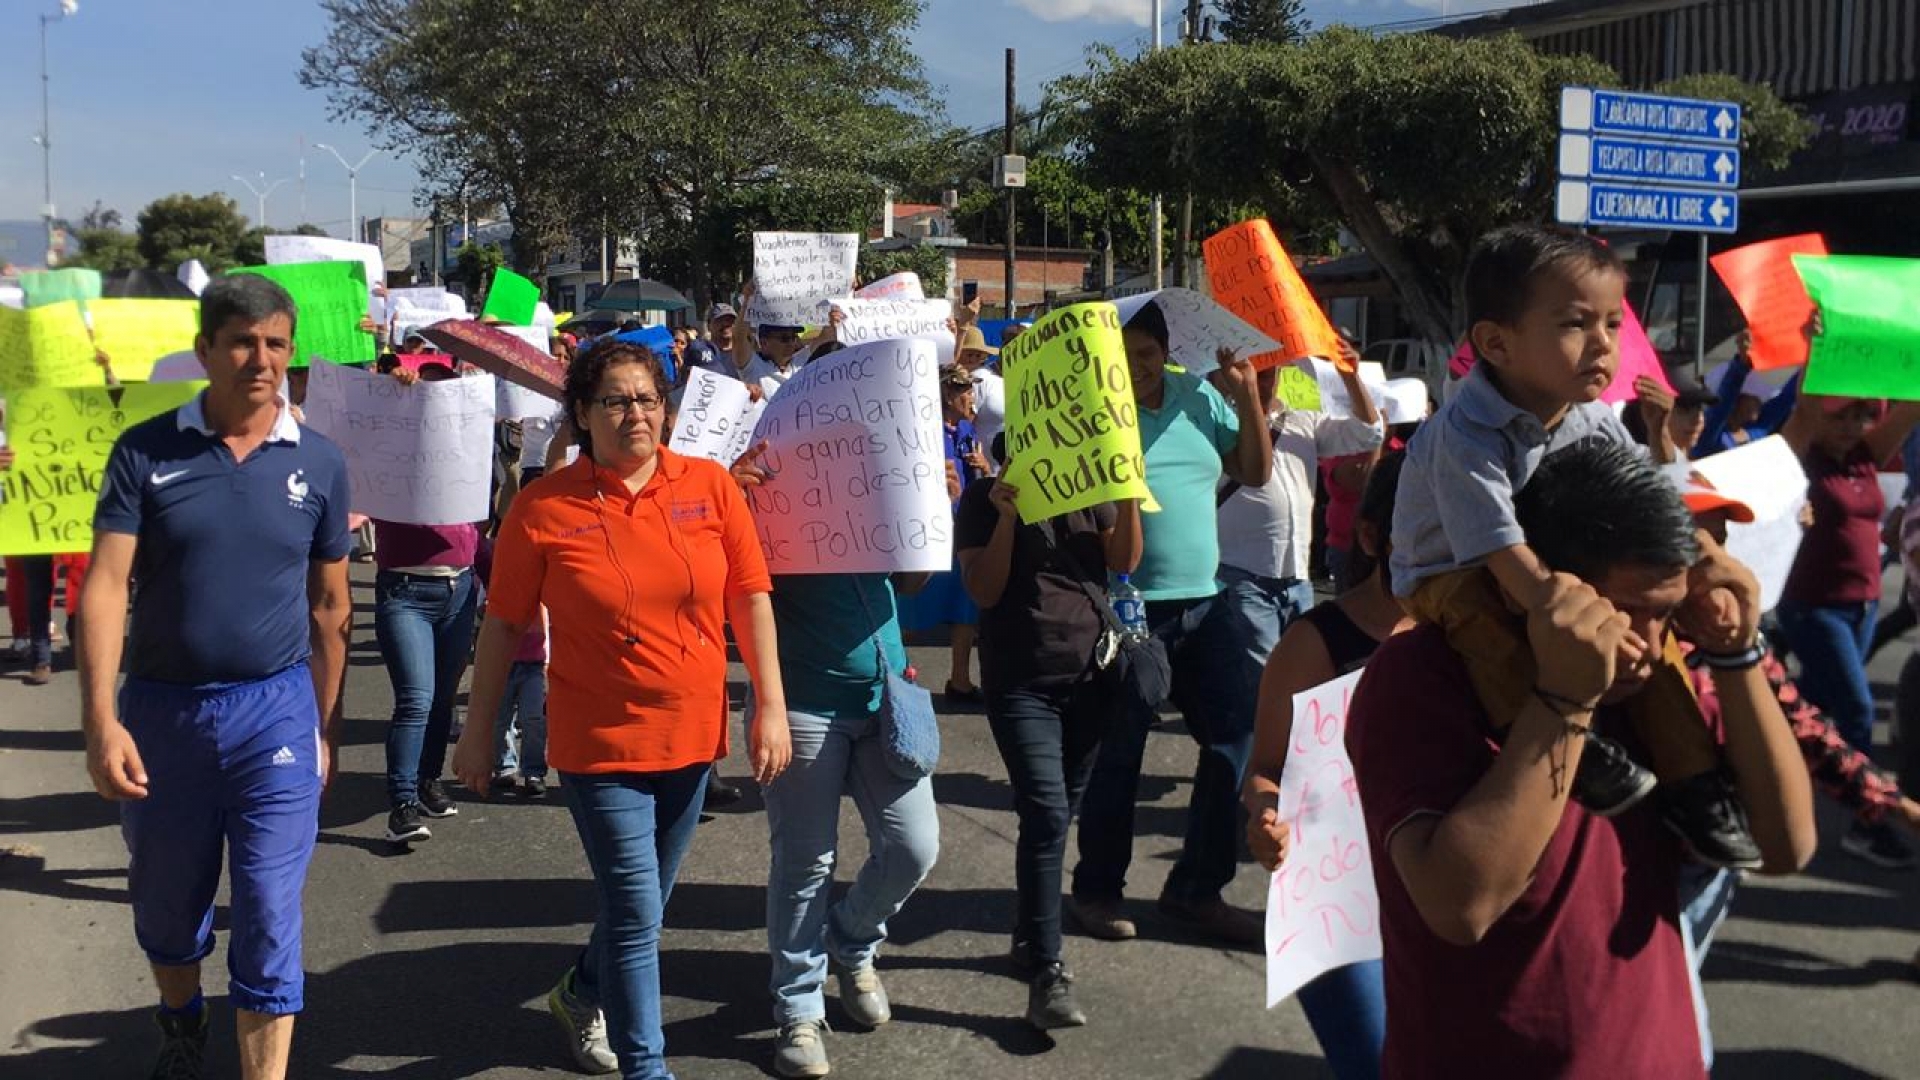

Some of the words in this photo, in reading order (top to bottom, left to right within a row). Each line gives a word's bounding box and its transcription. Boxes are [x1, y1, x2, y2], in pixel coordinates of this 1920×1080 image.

[1647, 103, 1666, 130] RUTA
[1645, 149, 1664, 174] RUTA
[1595, 191, 1668, 220] CUERNAVACA
[1672, 196, 1705, 223] LIBRE
[821, 263, 844, 280] las
[841, 322, 868, 342] No
[873, 321, 893, 340] te
[1065, 336, 1090, 374] y
[1093, 356, 1126, 392] lo
[1046, 396, 1136, 449] Nieto
[29, 427, 76, 458] Se
[796, 433, 888, 481] ganas
[802, 470, 833, 508] al
[799, 510, 949, 565] Policias
